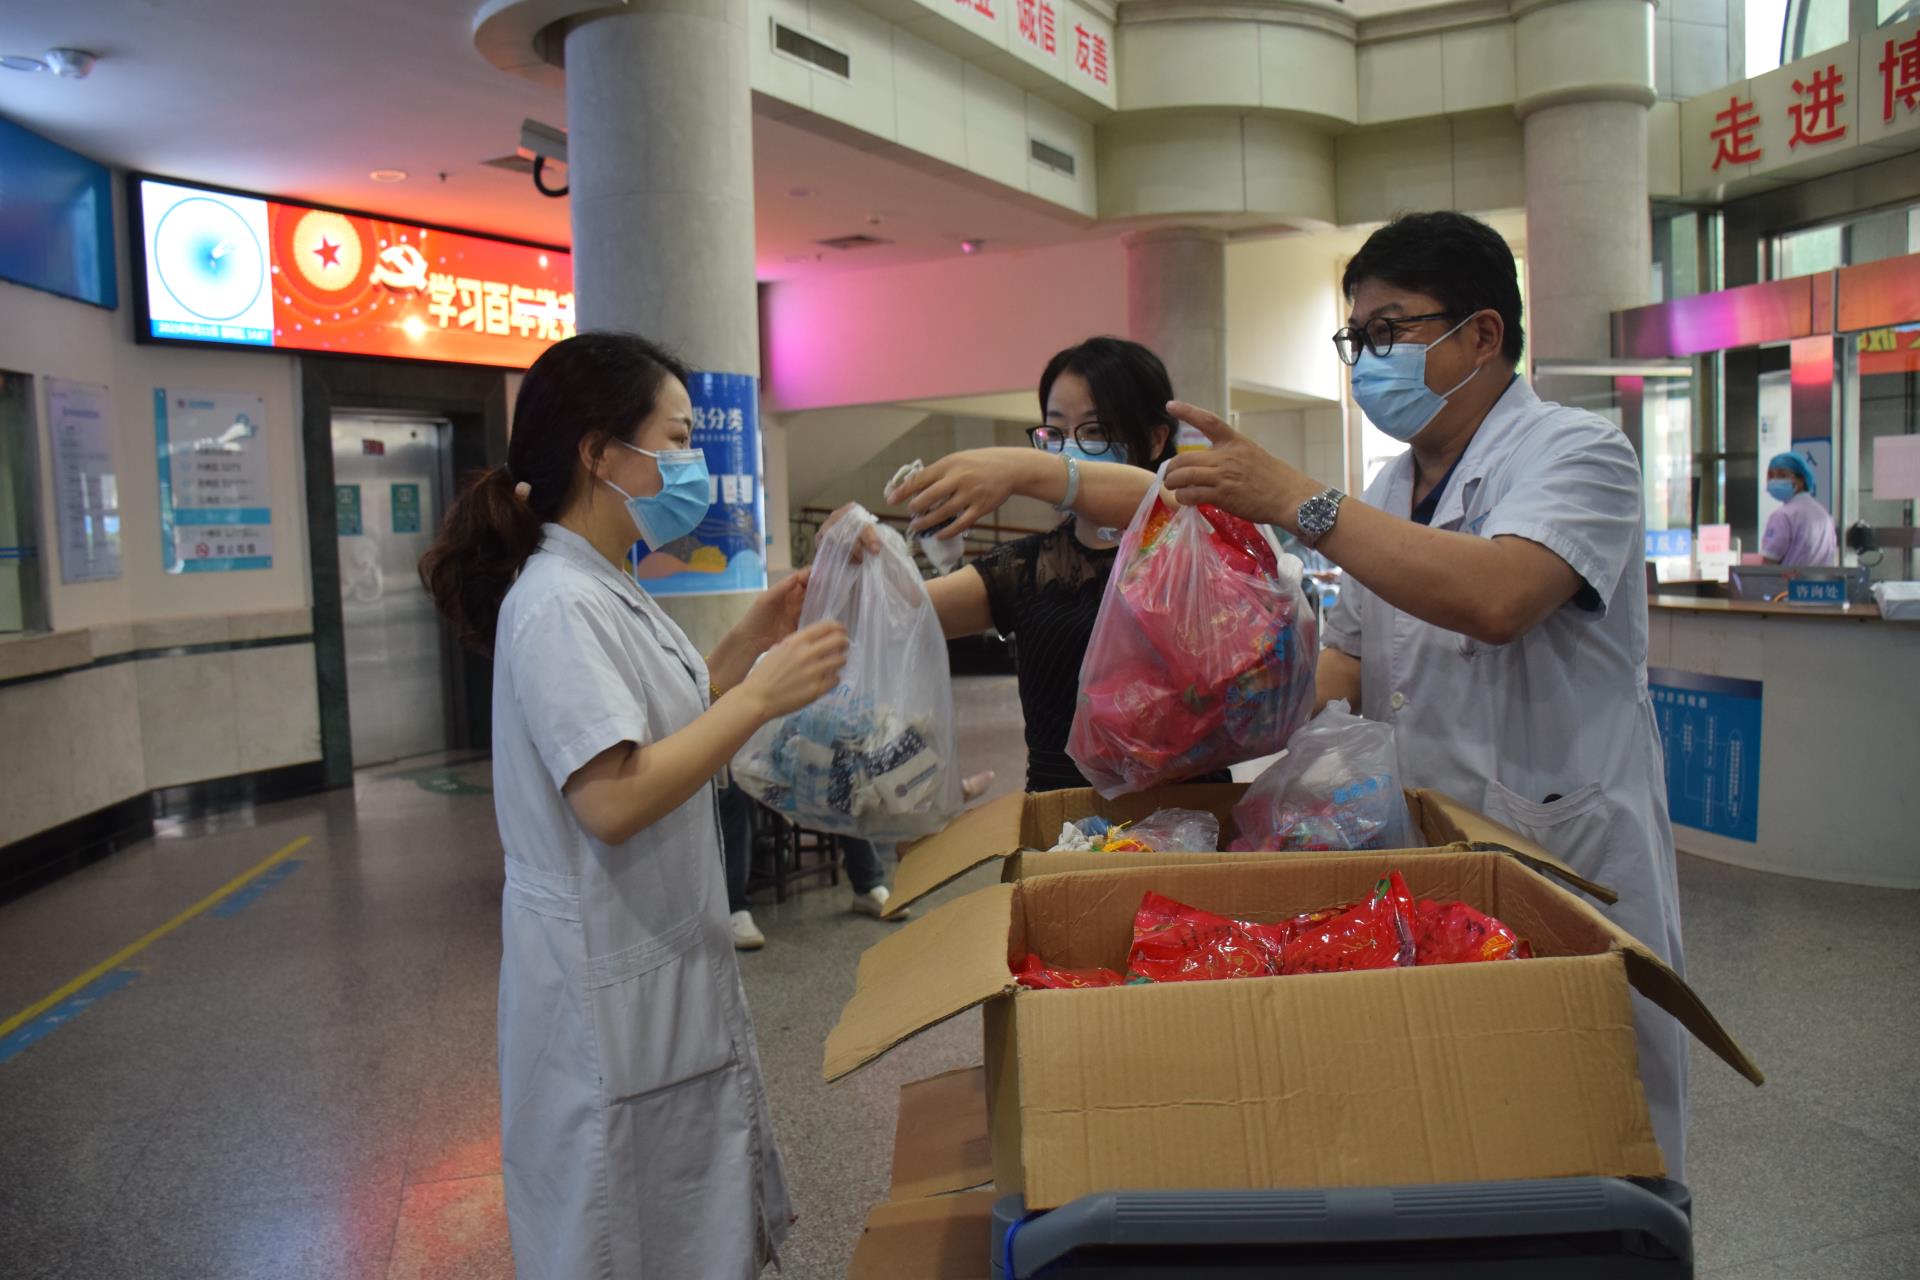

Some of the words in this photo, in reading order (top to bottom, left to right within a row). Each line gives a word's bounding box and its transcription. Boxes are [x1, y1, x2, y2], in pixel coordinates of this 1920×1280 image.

[1015, 0, 1057, 56] 诚信
[1073, 22, 1109, 86] 友善
[1708, 29, 1920, 173] 走进博
[1795, 583, 1840, 599] 咨询处
